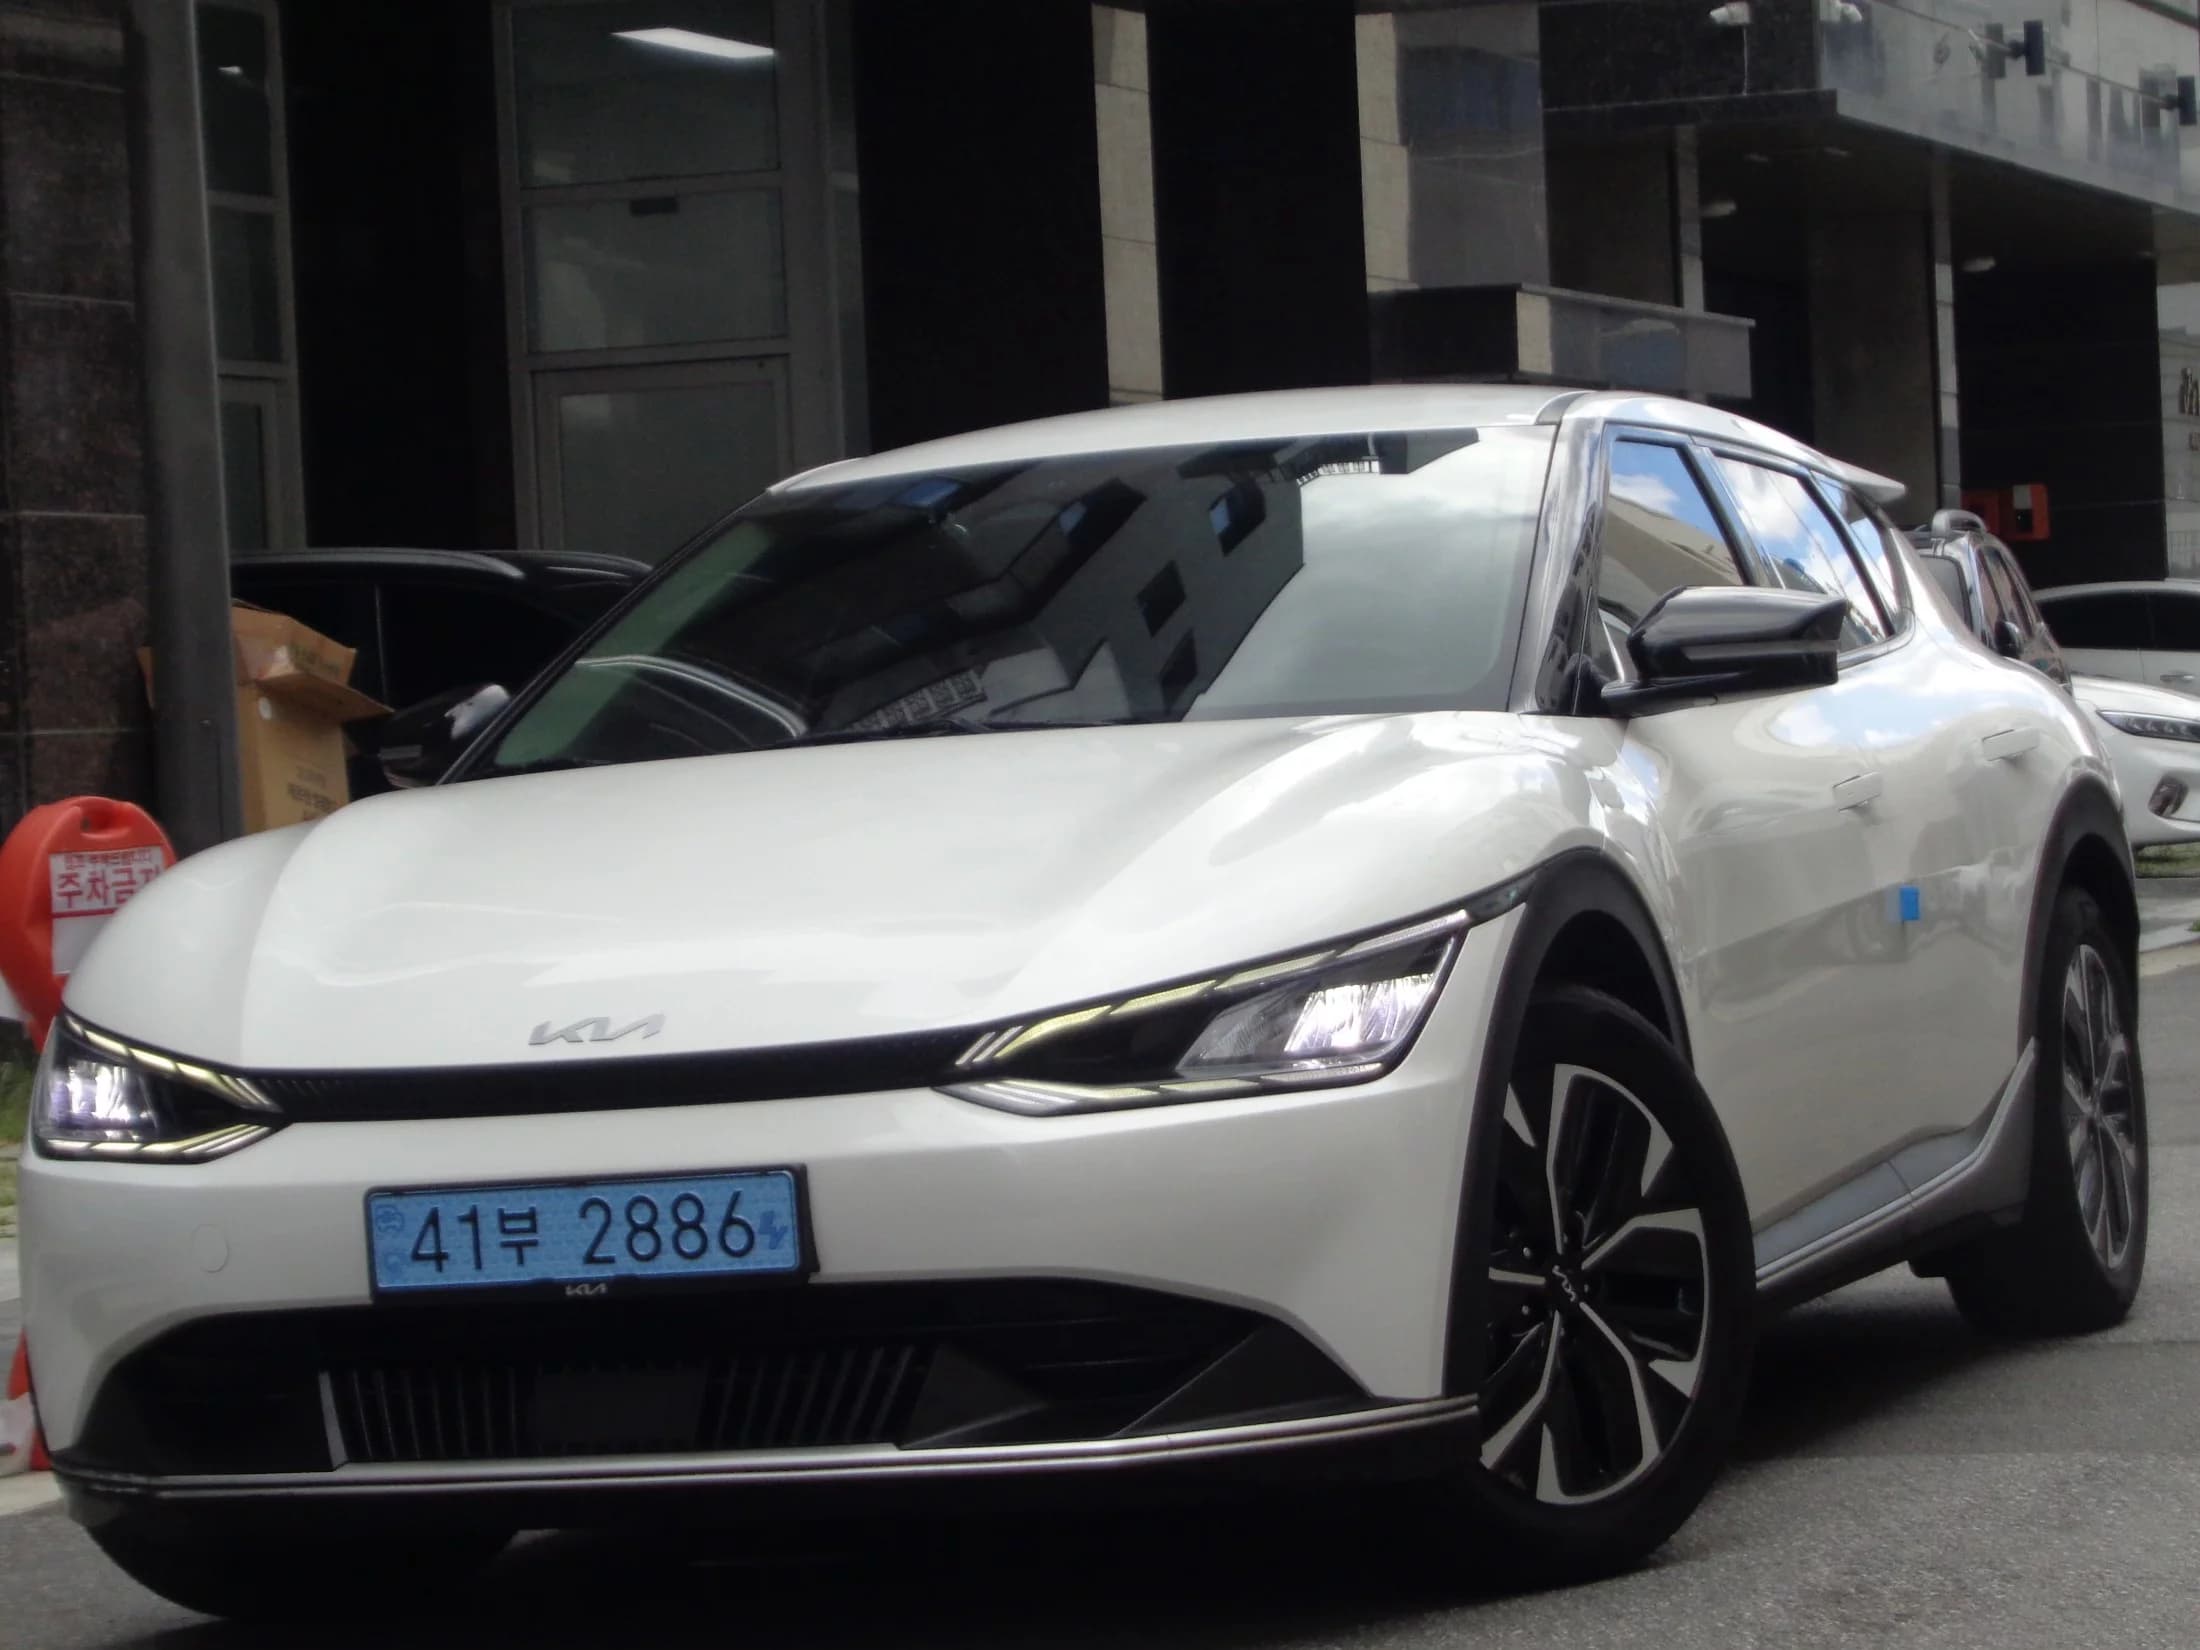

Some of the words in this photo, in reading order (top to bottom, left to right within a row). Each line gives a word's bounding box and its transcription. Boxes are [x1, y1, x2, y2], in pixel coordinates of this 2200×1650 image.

[528, 1012, 666, 1046] KIA
[410, 1203, 540, 1273] 41부
[578, 1189, 756, 1267] 2886
